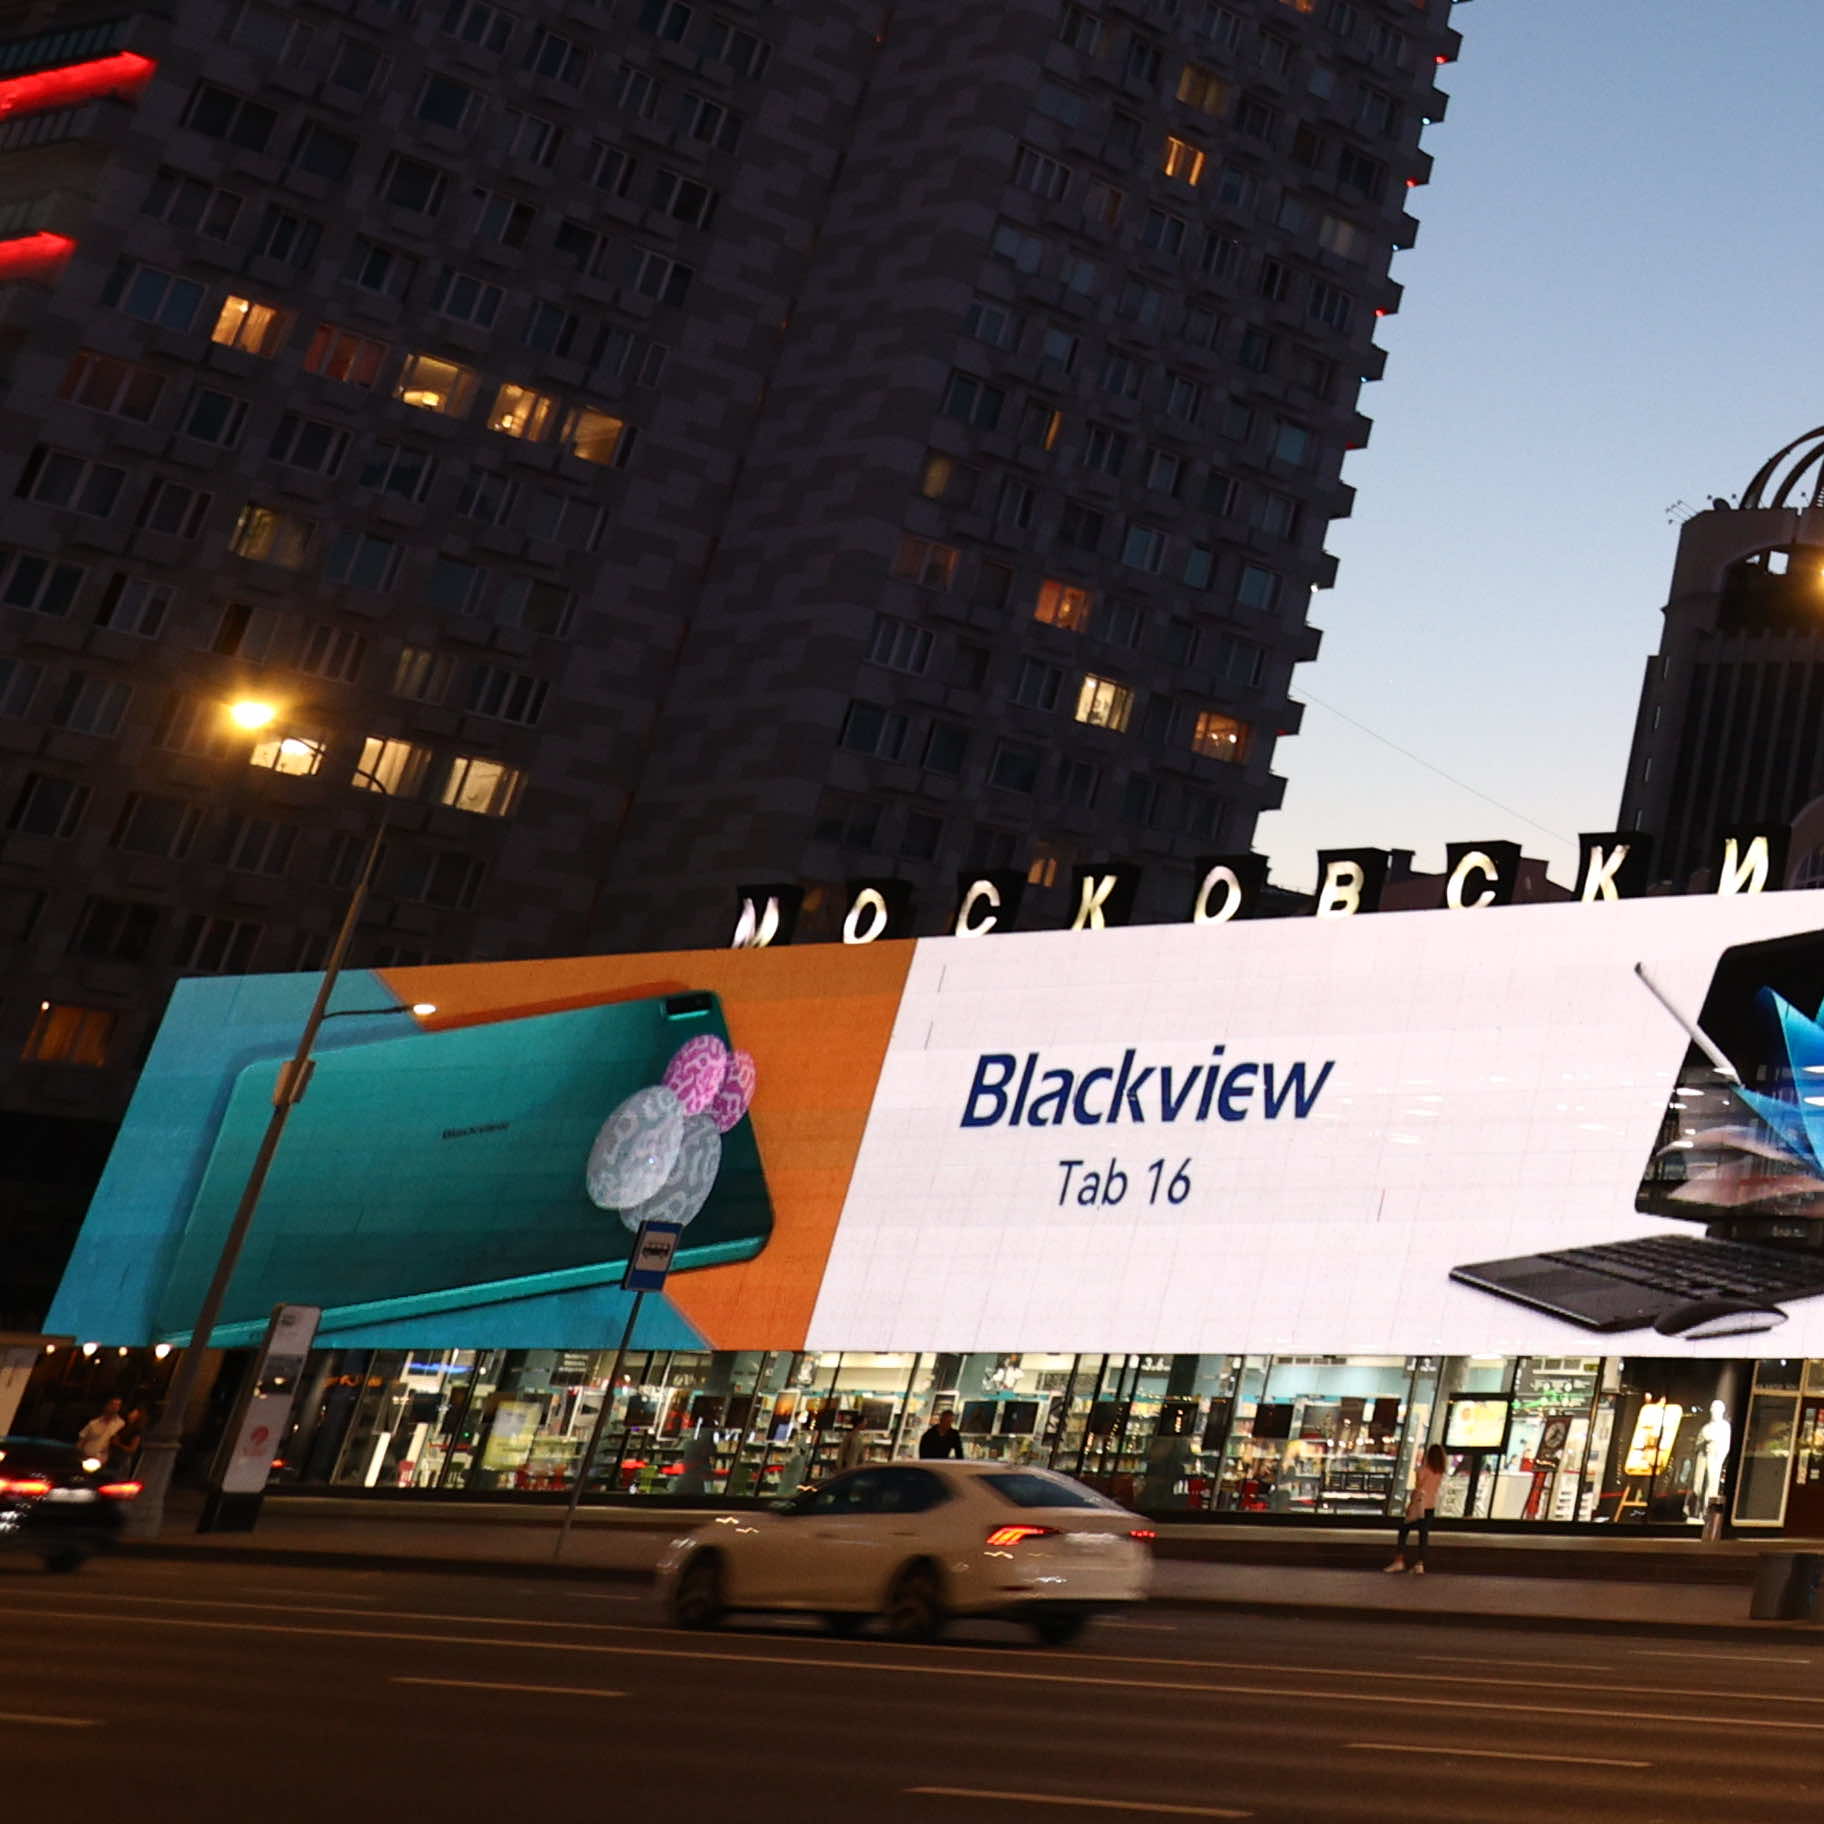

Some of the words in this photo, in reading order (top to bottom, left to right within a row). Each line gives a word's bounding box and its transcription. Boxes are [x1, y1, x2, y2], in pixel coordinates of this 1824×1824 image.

[959, 1045, 1336, 1128] Blackview
[1059, 1157, 1128, 1206] Tab
[1148, 1157, 1192, 1205] 16
